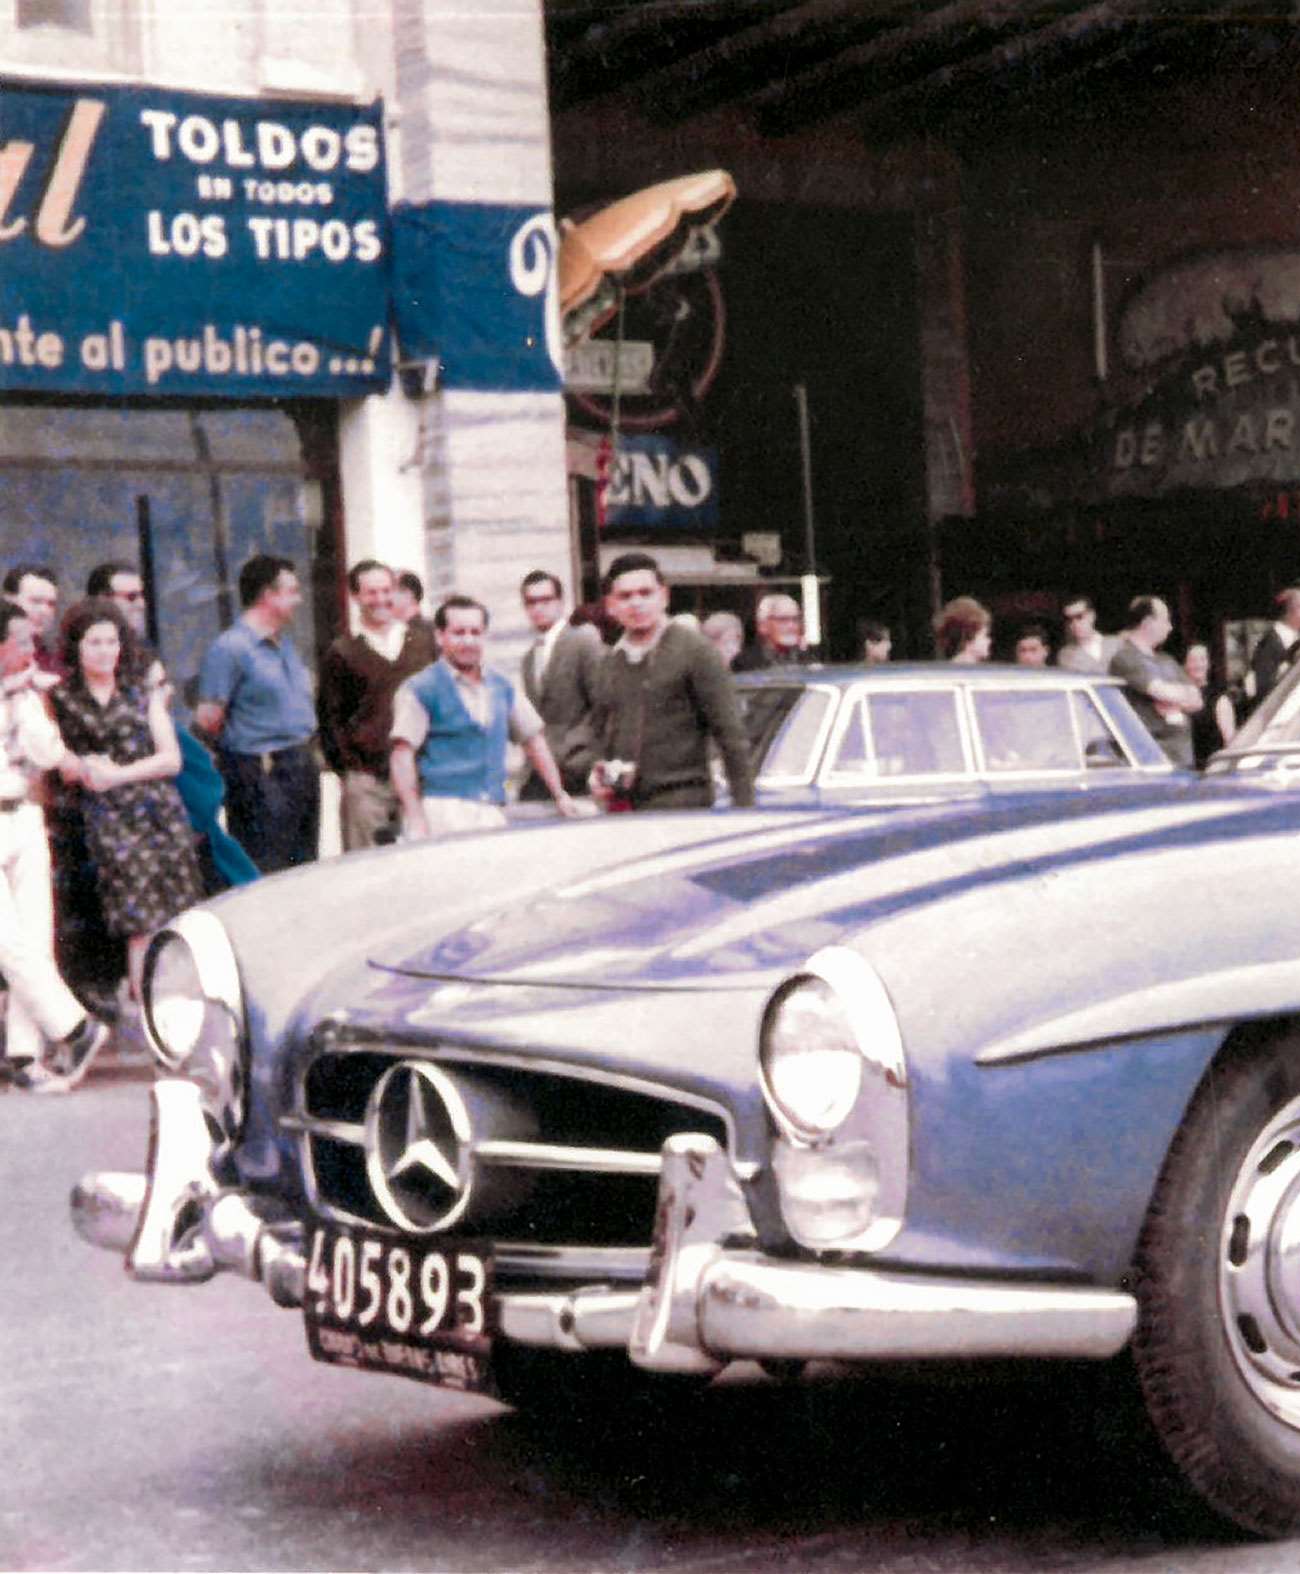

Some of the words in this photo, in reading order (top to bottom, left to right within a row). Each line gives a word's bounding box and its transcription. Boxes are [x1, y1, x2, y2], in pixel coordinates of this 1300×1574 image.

[140, 109, 378, 172] TOLDOS
[198, 175, 232, 200] EN
[243, 179, 333, 205] TODOS
[148, 210, 228, 257] LOS
[247, 217, 382, 262] TIPOS
[81, 319, 124, 371] al
[1113, 424, 1164, 469] DE
[1184, 408, 1296, 460] MAR
[308, 1229, 486, 1336] 405893
